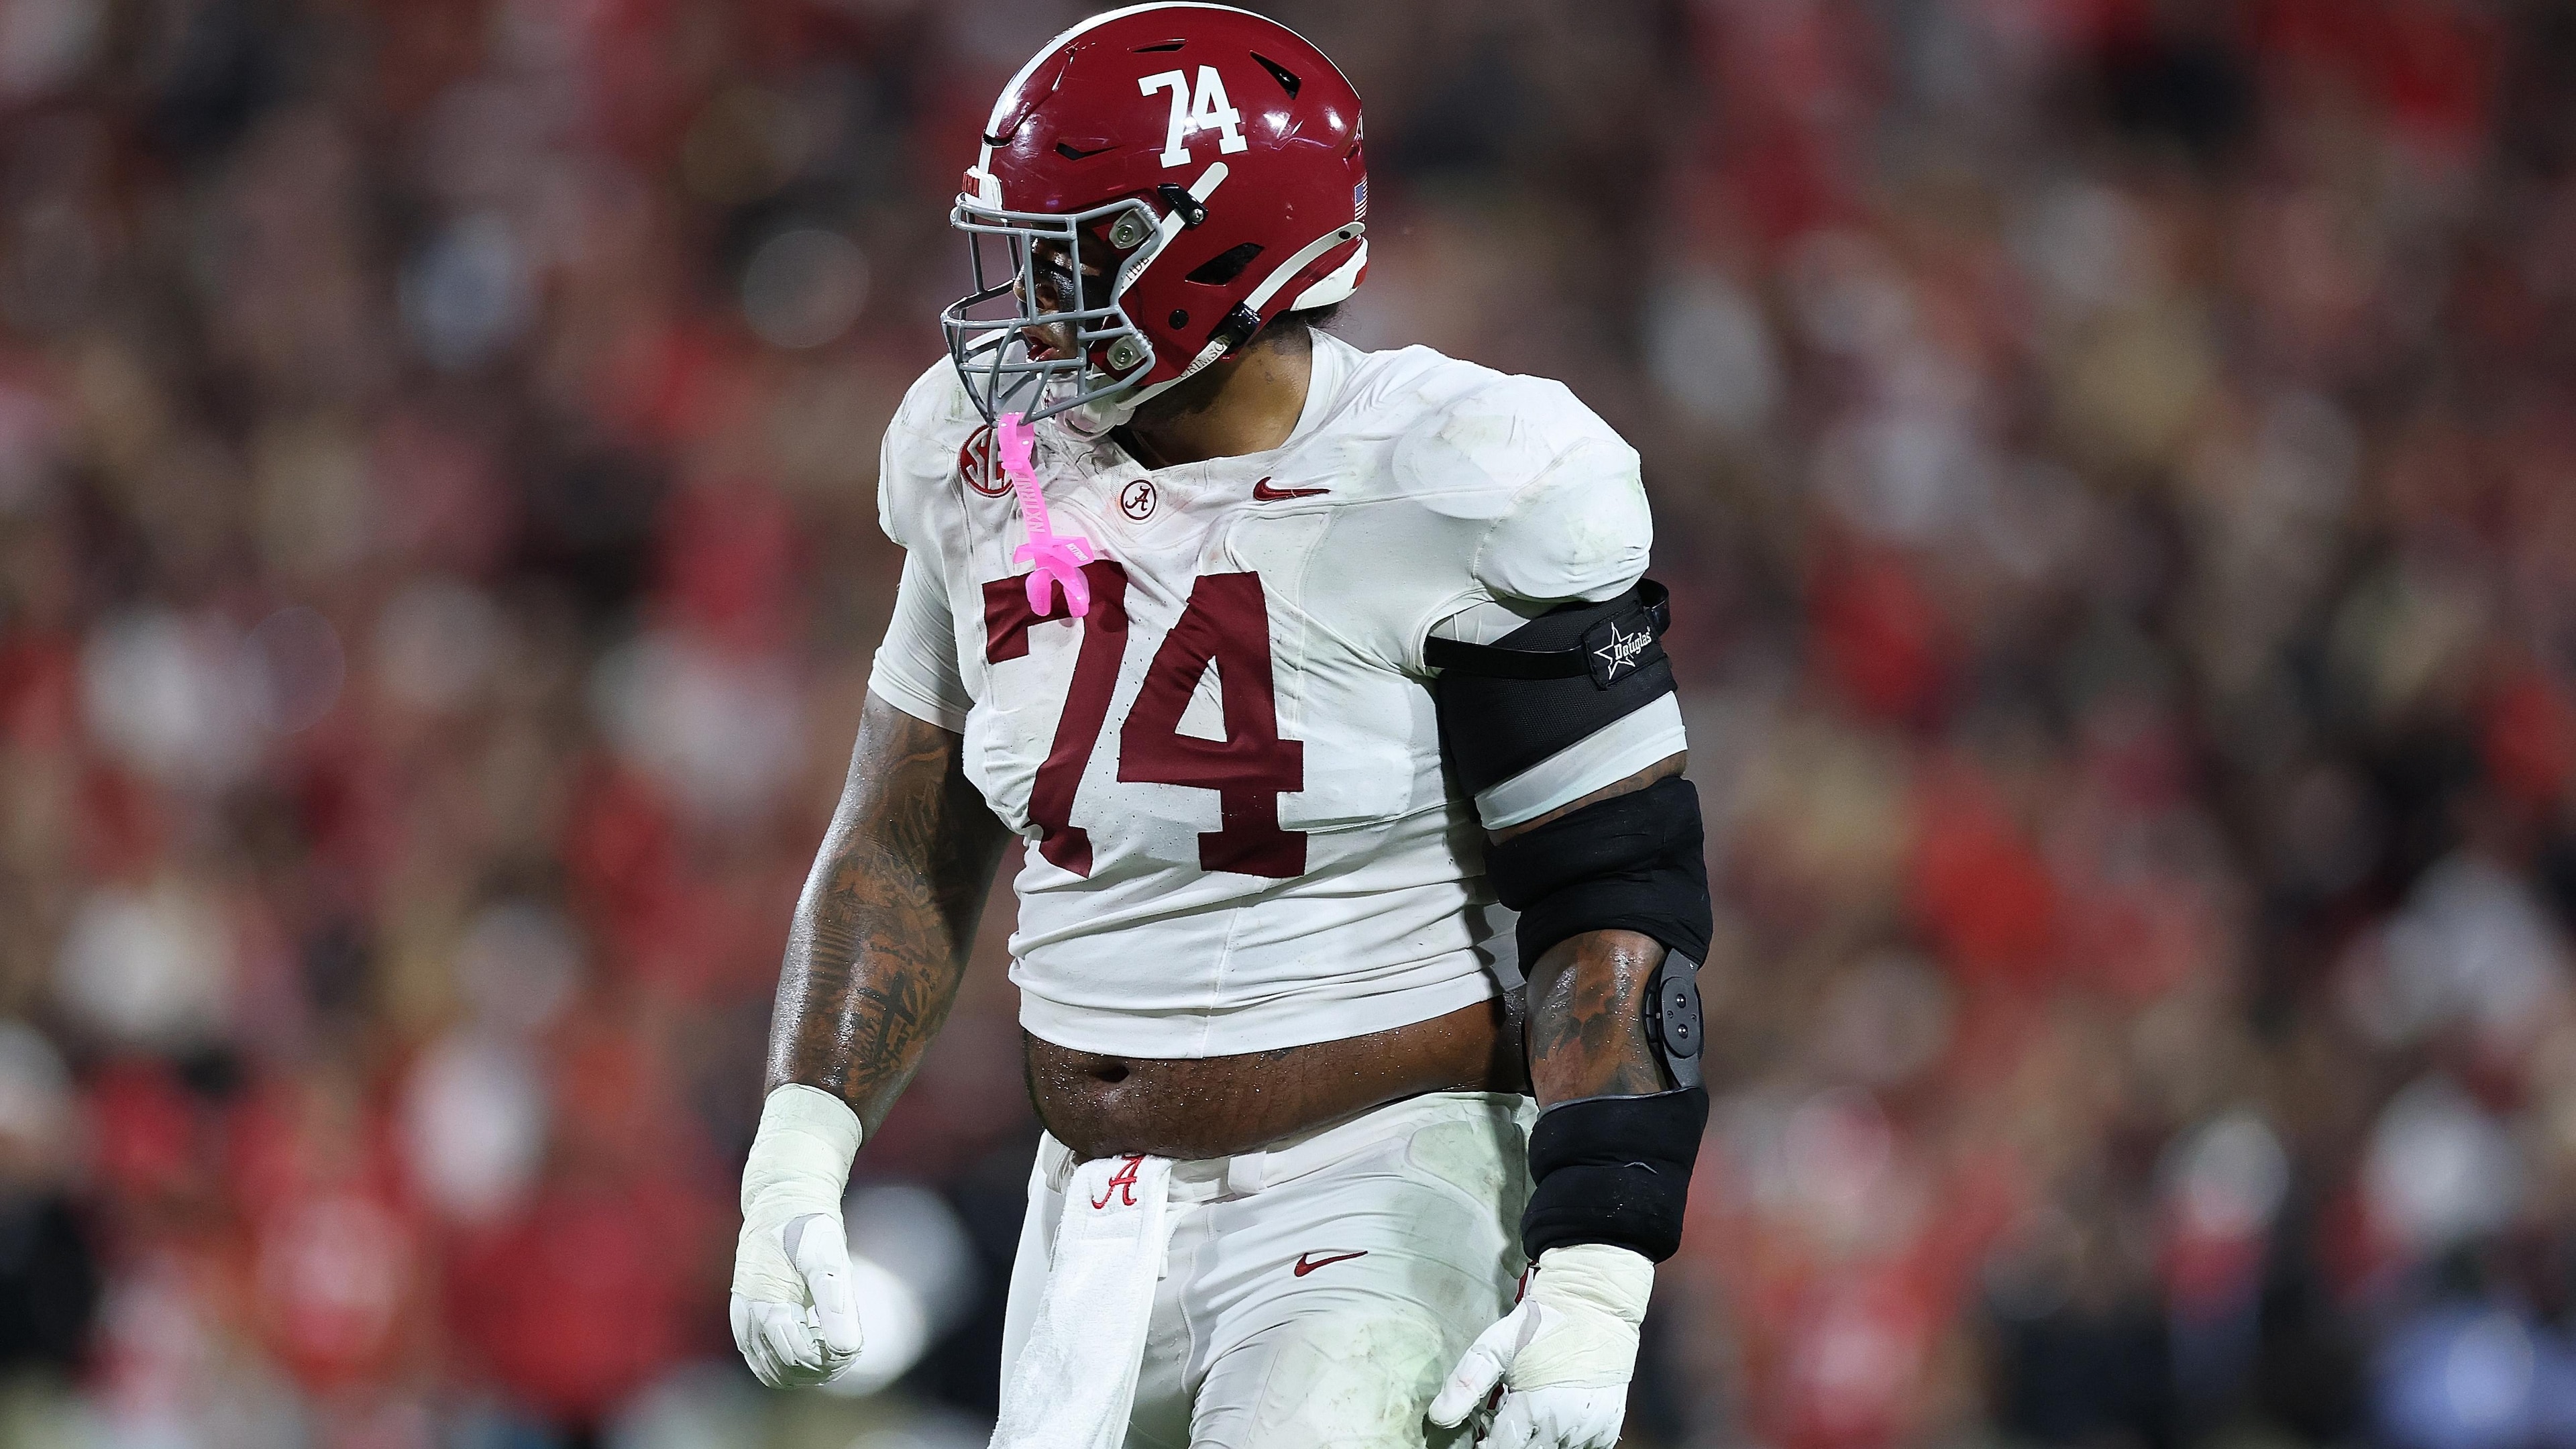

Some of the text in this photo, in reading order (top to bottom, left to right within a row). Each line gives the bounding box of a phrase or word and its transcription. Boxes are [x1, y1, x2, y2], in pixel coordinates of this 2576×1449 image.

[1138, 65, 1248, 168] 74
[966, 427, 1012, 490] SE
[1125, 486, 1150, 511] A
[1614, 631, 1652, 660] Douglas
[982, 559, 1307, 879] 74
[1091, 1155, 1145, 1209] A
